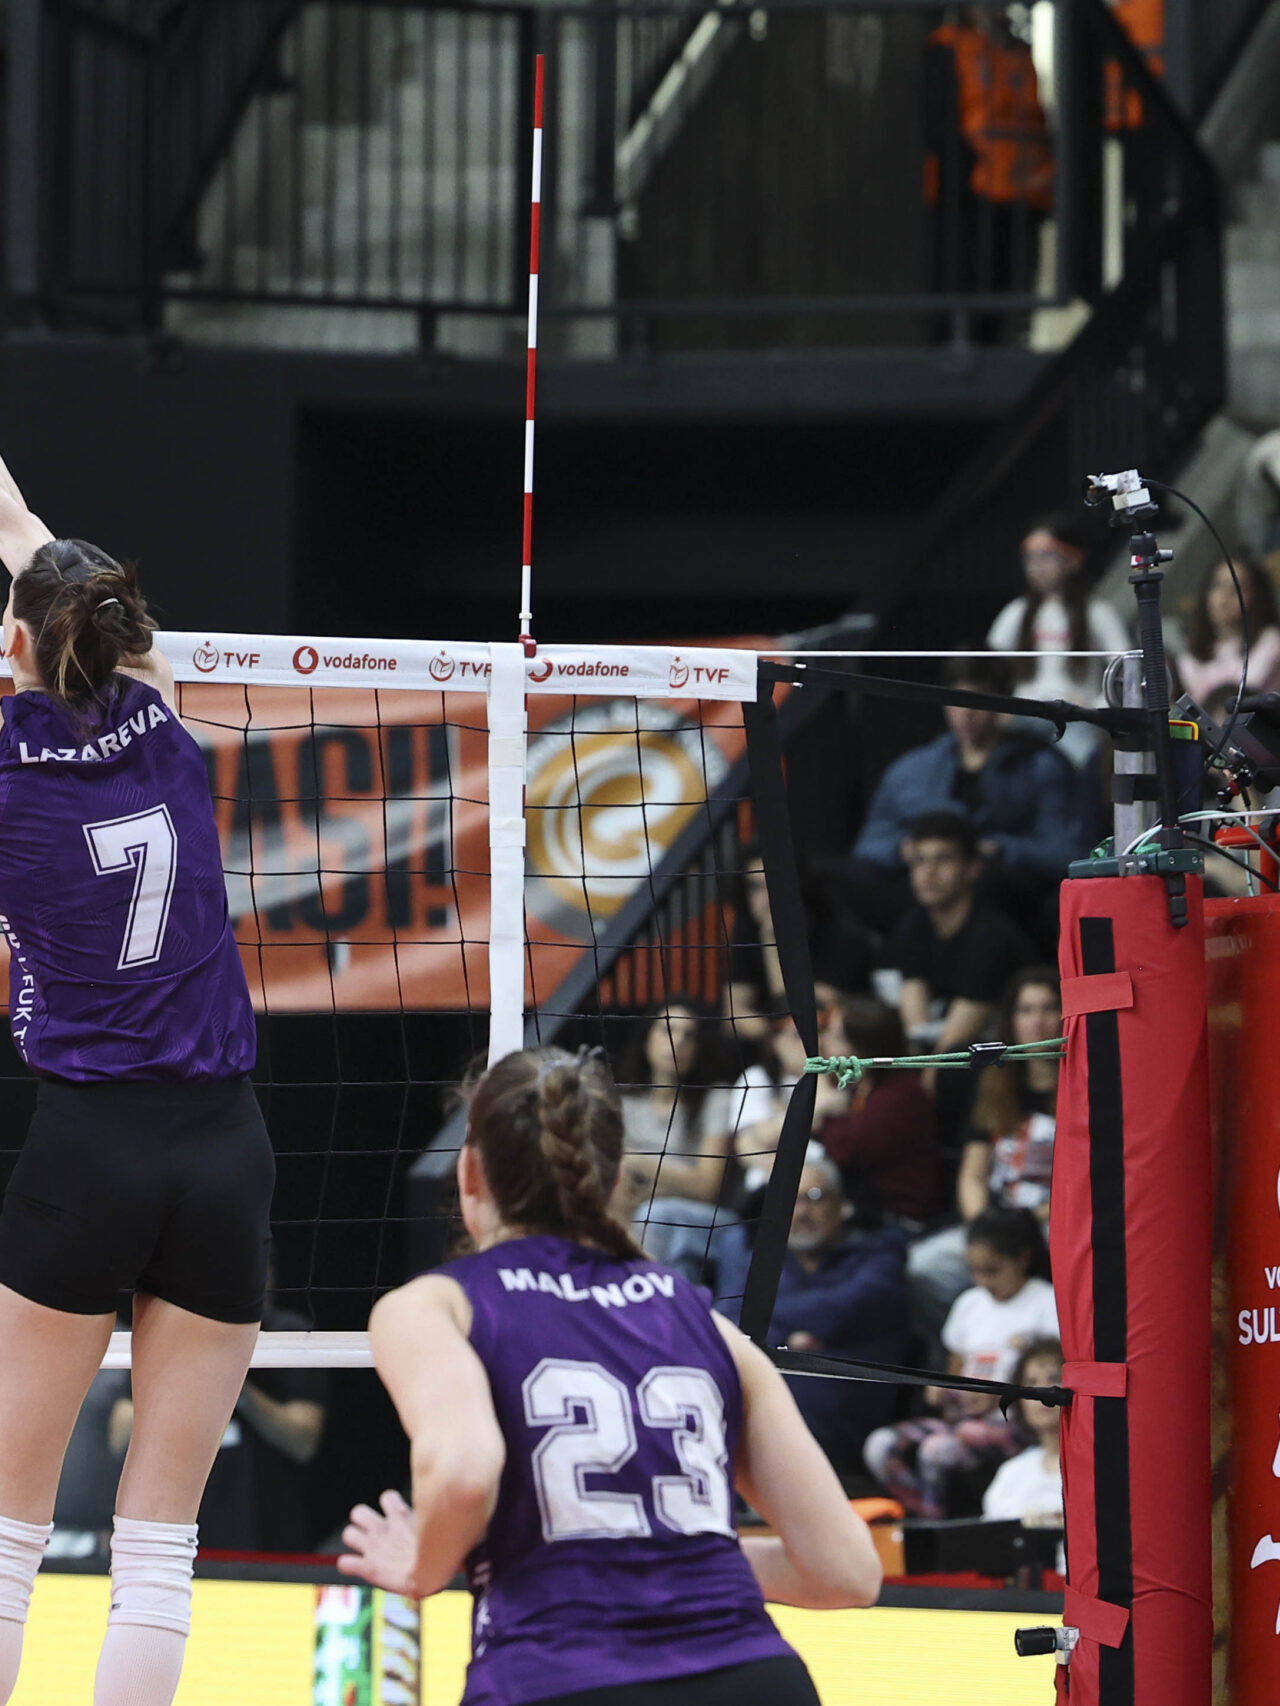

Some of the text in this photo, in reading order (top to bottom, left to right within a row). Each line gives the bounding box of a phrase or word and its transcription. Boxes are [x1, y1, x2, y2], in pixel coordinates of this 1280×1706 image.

[224, 652, 260, 668] TVF
[324, 653, 397, 670] vodafone
[558, 661, 629, 677] vodafone
[693, 668, 730, 683] TVF
[19, 703, 168, 764] LAZAREVA
[82, 803, 178, 970] 7
[497, 1267, 675, 1308] MALNOV
[1238, 1306, 1280, 1346] SUL
[521, 1357, 738, 1543] 23
